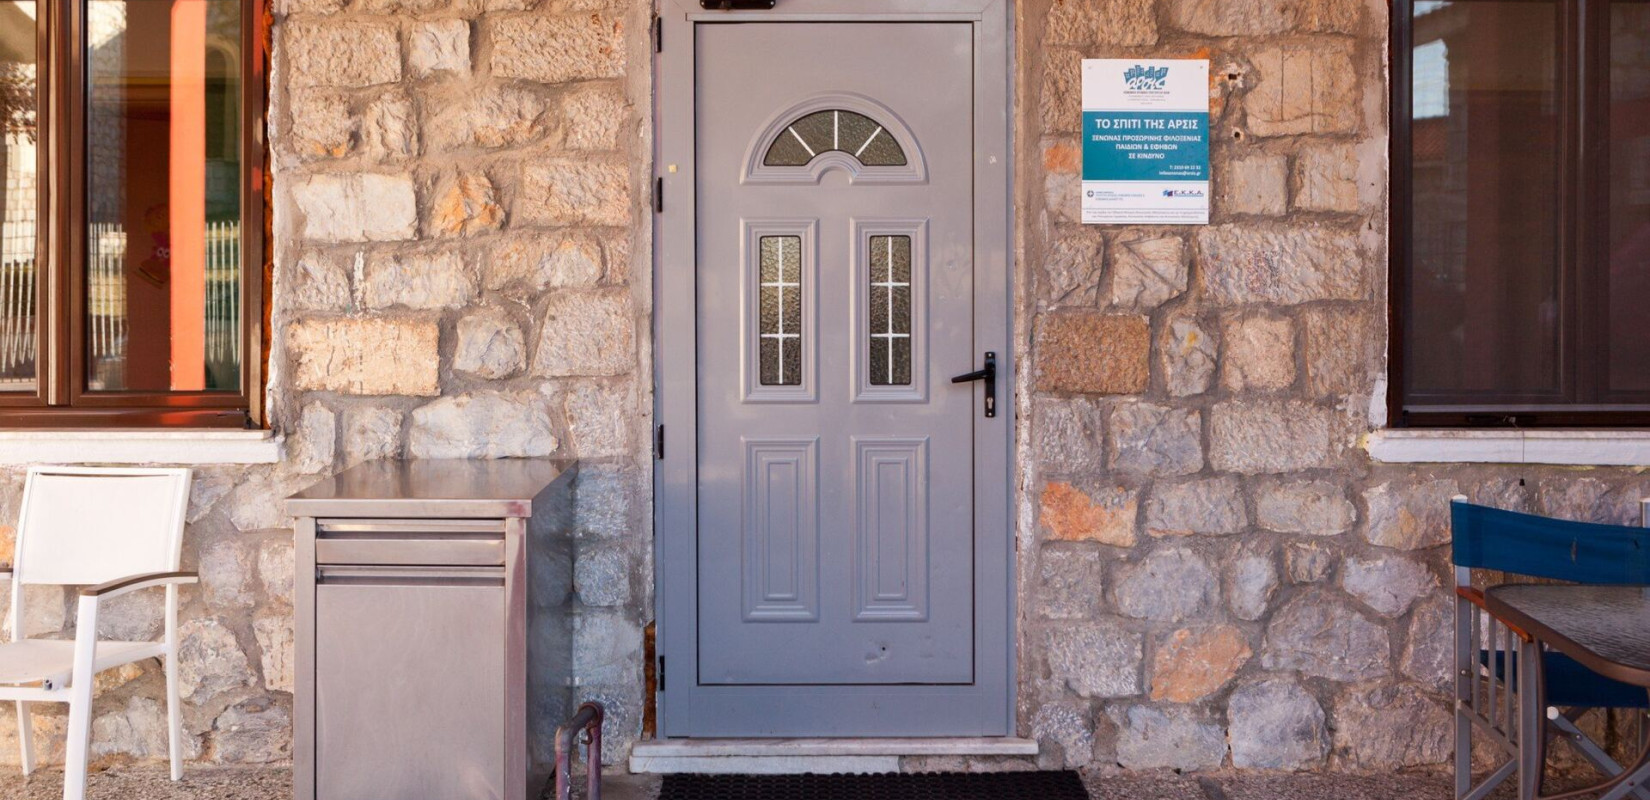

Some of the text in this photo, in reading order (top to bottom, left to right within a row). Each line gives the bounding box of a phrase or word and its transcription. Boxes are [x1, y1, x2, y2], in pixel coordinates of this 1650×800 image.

[1095, 119, 1198, 129] ΤΟ ΣΠΙΤΙ ΤΗΣ ΑΡΣΙΣ
